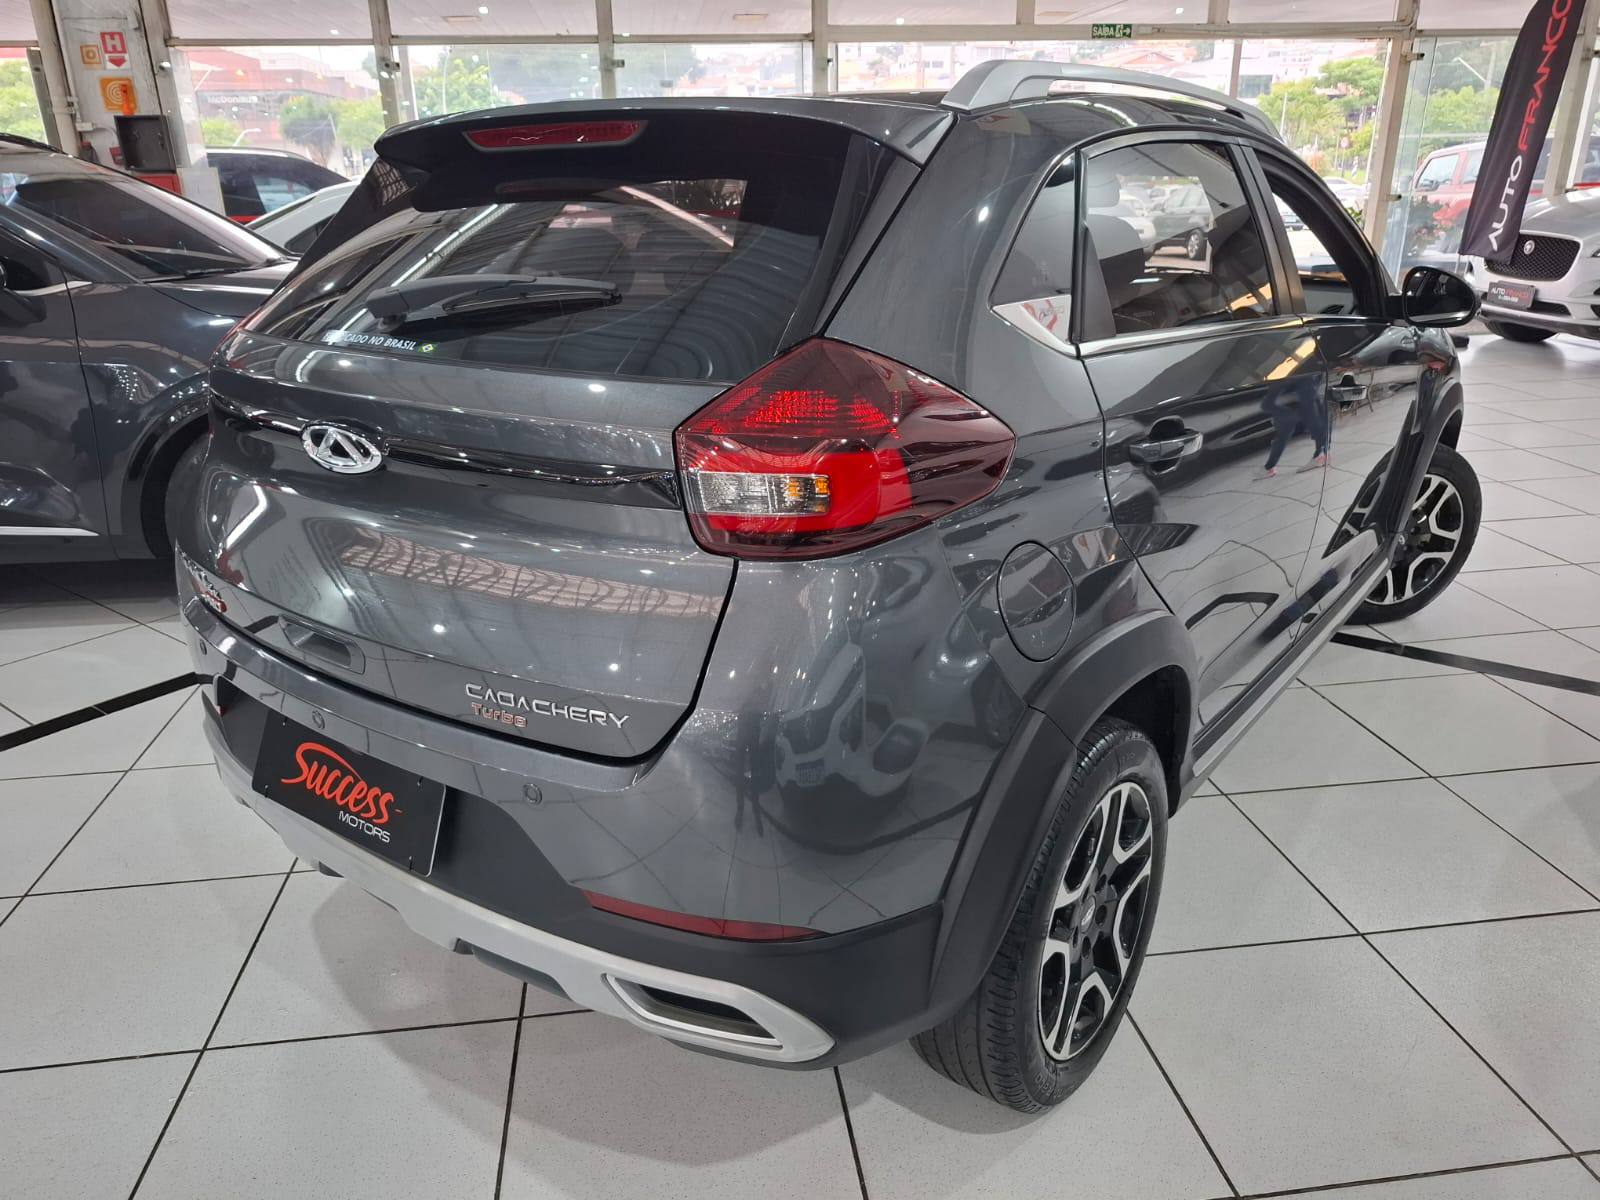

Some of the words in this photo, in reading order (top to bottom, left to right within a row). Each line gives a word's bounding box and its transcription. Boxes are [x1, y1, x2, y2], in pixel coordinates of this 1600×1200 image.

[103, 34, 124, 52] H
[1488, 155, 1523, 251] AUTO
[369, 336, 384, 345] NO
[384, 339, 416, 350] BRASIL
[471, 702, 528, 728] Turbo
[281, 742, 396, 825] Success
[338, 810, 392, 844] MOTORS
